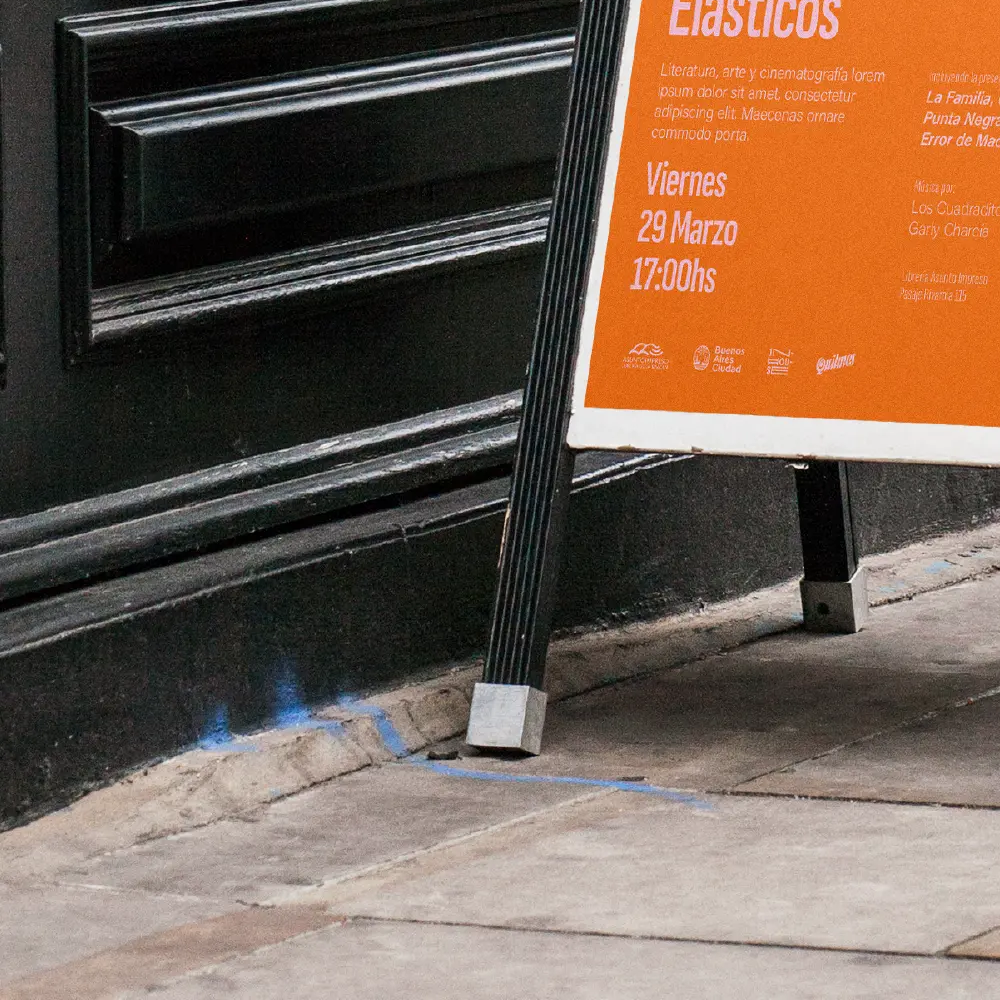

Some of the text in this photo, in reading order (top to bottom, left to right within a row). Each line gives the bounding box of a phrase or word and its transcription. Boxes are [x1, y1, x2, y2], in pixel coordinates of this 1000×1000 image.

[660, 63, 886, 83] Literatura, arte y cinematografía lorem
[657, 84, 694, 100] ipsum
[697, 85, 728, 99] dolor
[730, 86, 745, 99] sit
[784, 88, 856, 103] consectetur
[926, 90, 943, 104] La
[946, 90, 994, 107] Familia,
[653, 105, 714, 122] adipiscing
[807, 110, 846, 124] ornare
[923, 112, 961, 126] Punta
[651, 127, 712, 141] commodo
[920, 132, 953, 146] Error
[956, 133, 972, 147] de
[647, 161, 728, 197] Viernes
[911, 200, 933, 215] Los
[637, 209, 738, 246] 29 Marzo
[630, 257, 717, 293] 17:00hs
[714, 345, 745, 355] Buenos
[713, 355, 734, 364] Aires
[711, 364, 741, 374] Ciudad
